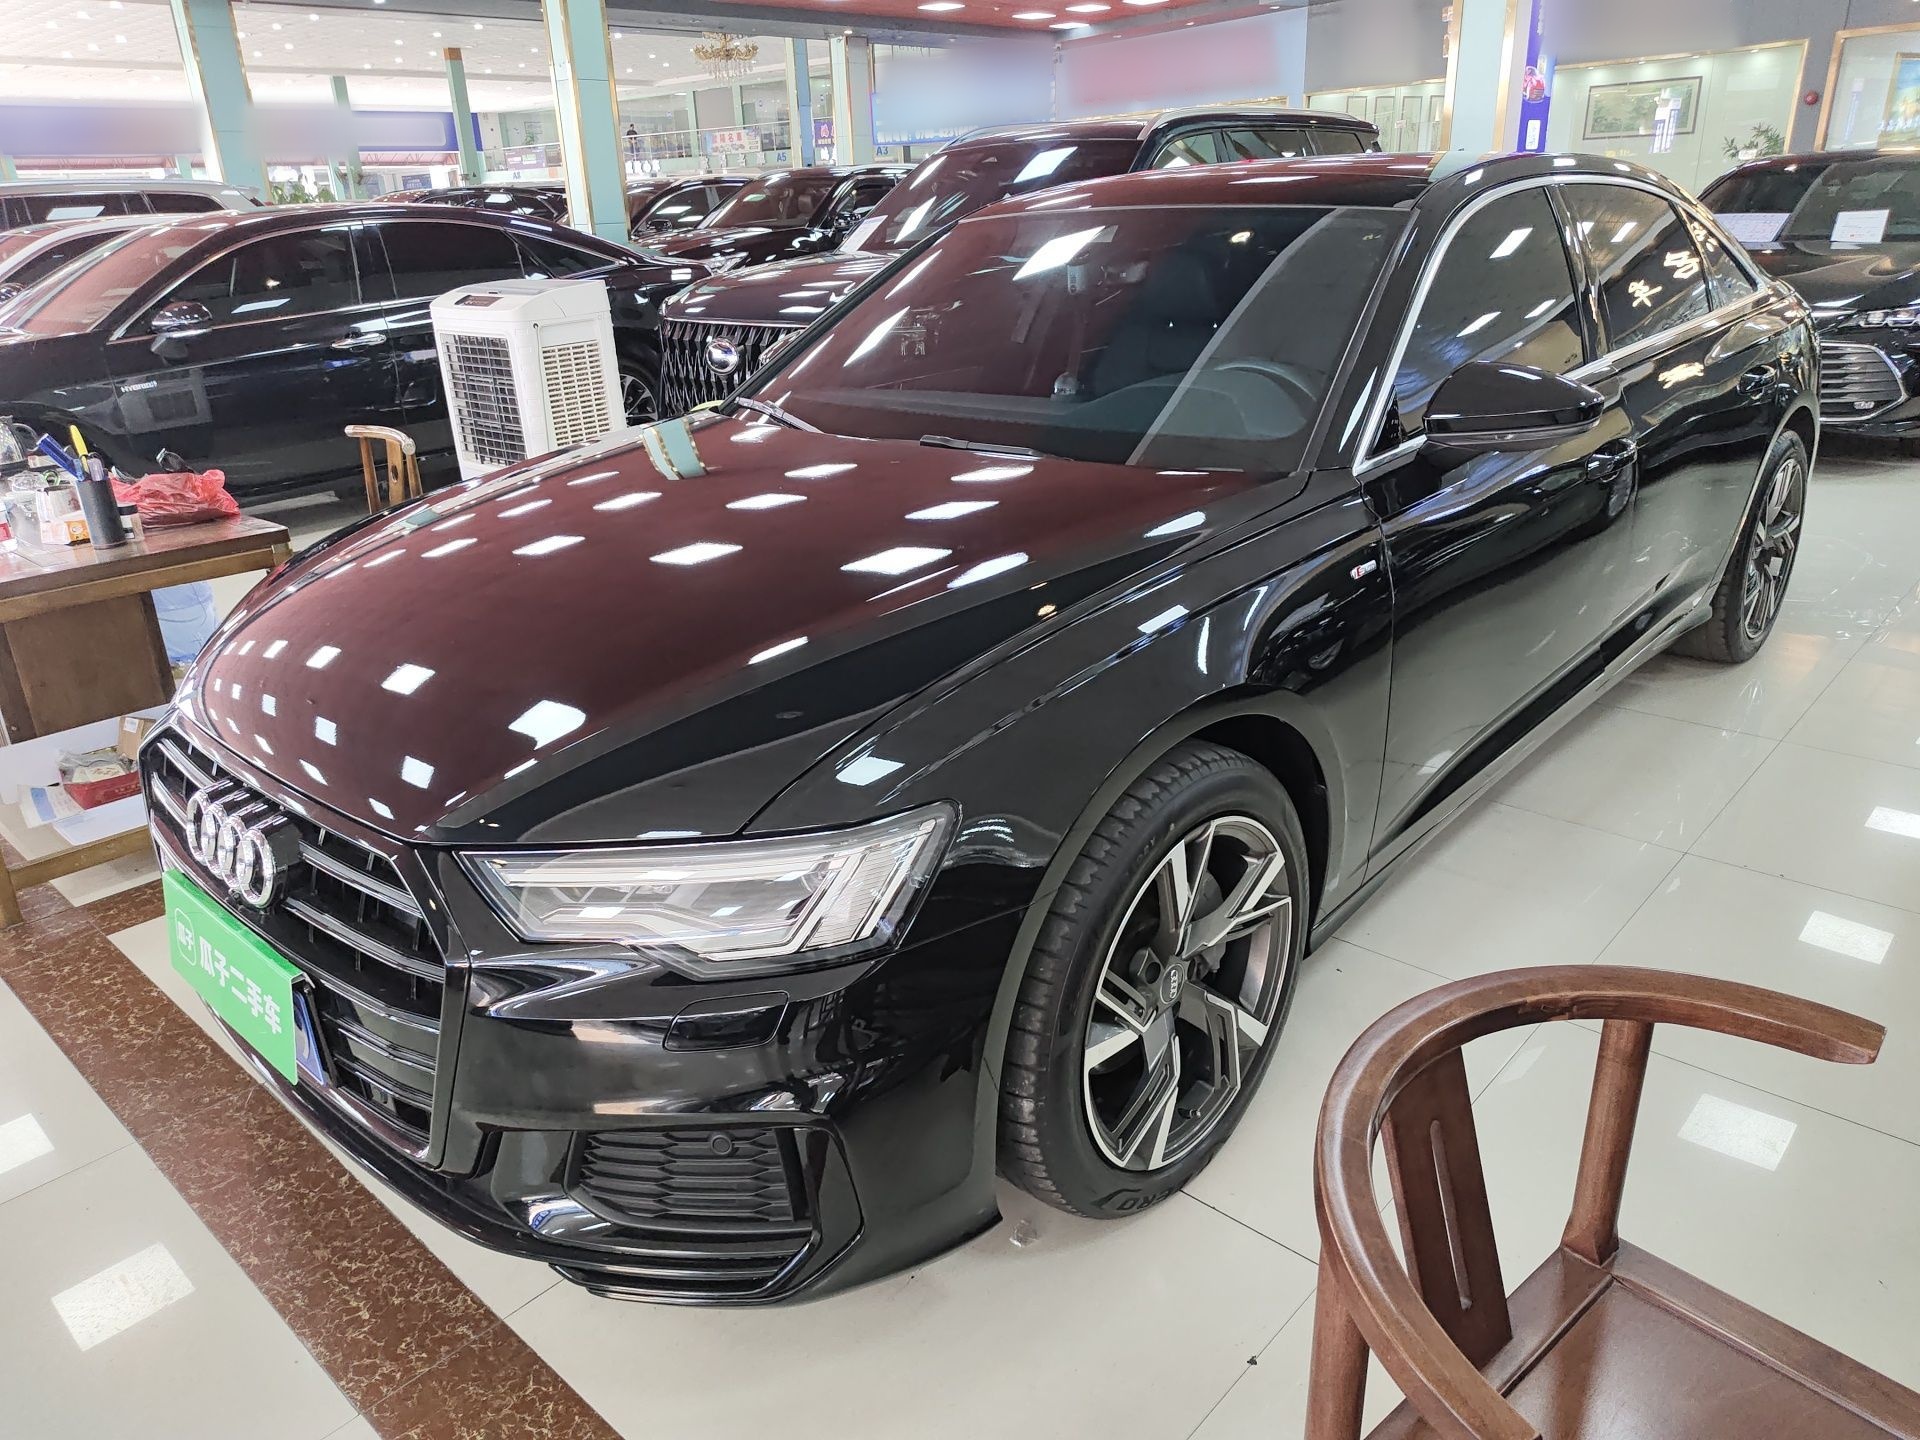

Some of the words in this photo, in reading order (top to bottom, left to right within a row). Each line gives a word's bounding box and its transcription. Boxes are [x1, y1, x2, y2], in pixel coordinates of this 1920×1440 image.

[776, 152, 787, 162] A5
[876, 146, 889, 156] A3
[176, 920, 194, 951] 瓜子
[199, 936, 282, 1035] 瓜子二手车
